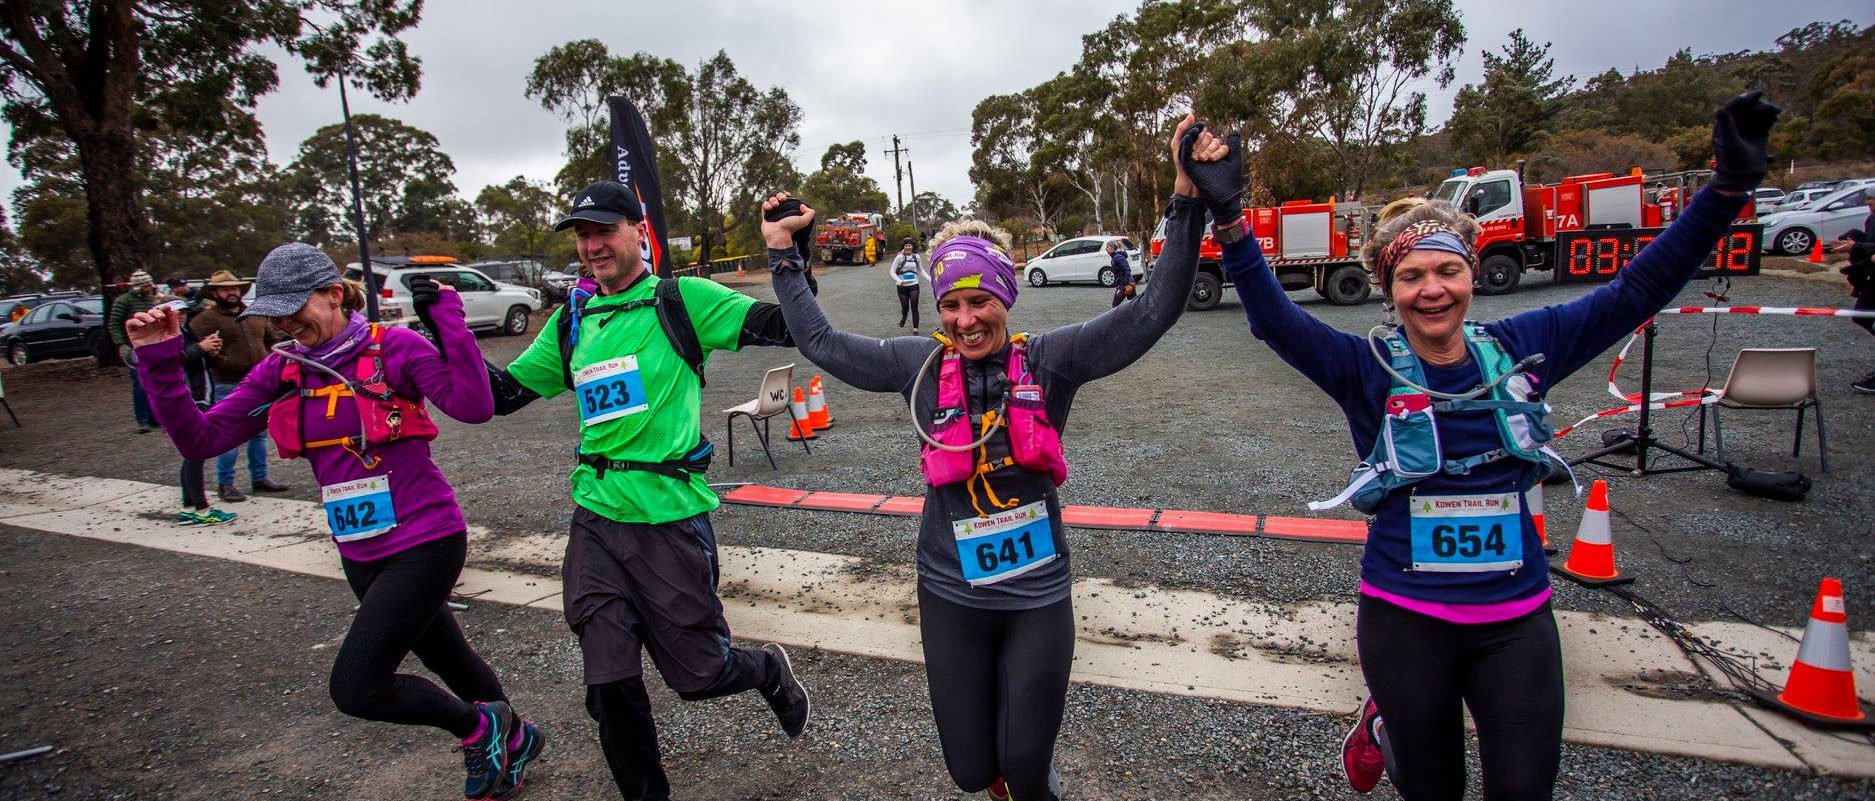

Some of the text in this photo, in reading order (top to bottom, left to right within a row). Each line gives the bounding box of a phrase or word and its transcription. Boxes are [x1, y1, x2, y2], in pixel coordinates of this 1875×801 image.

[616, 145, 632, 188] Adv
[1557, 214, 1578, 228] 7A
[584, 380, 630, 413] 523
[334, 501, 378, 531] 642
[1435, 498, 1499, 509] KOWEN TRAIL RUN
[973, 511, 1027, 529] KOWEN TRAIL RUN
[976, 531, 1034, 572] 641
[1432, 524, 1506, 558] 654
